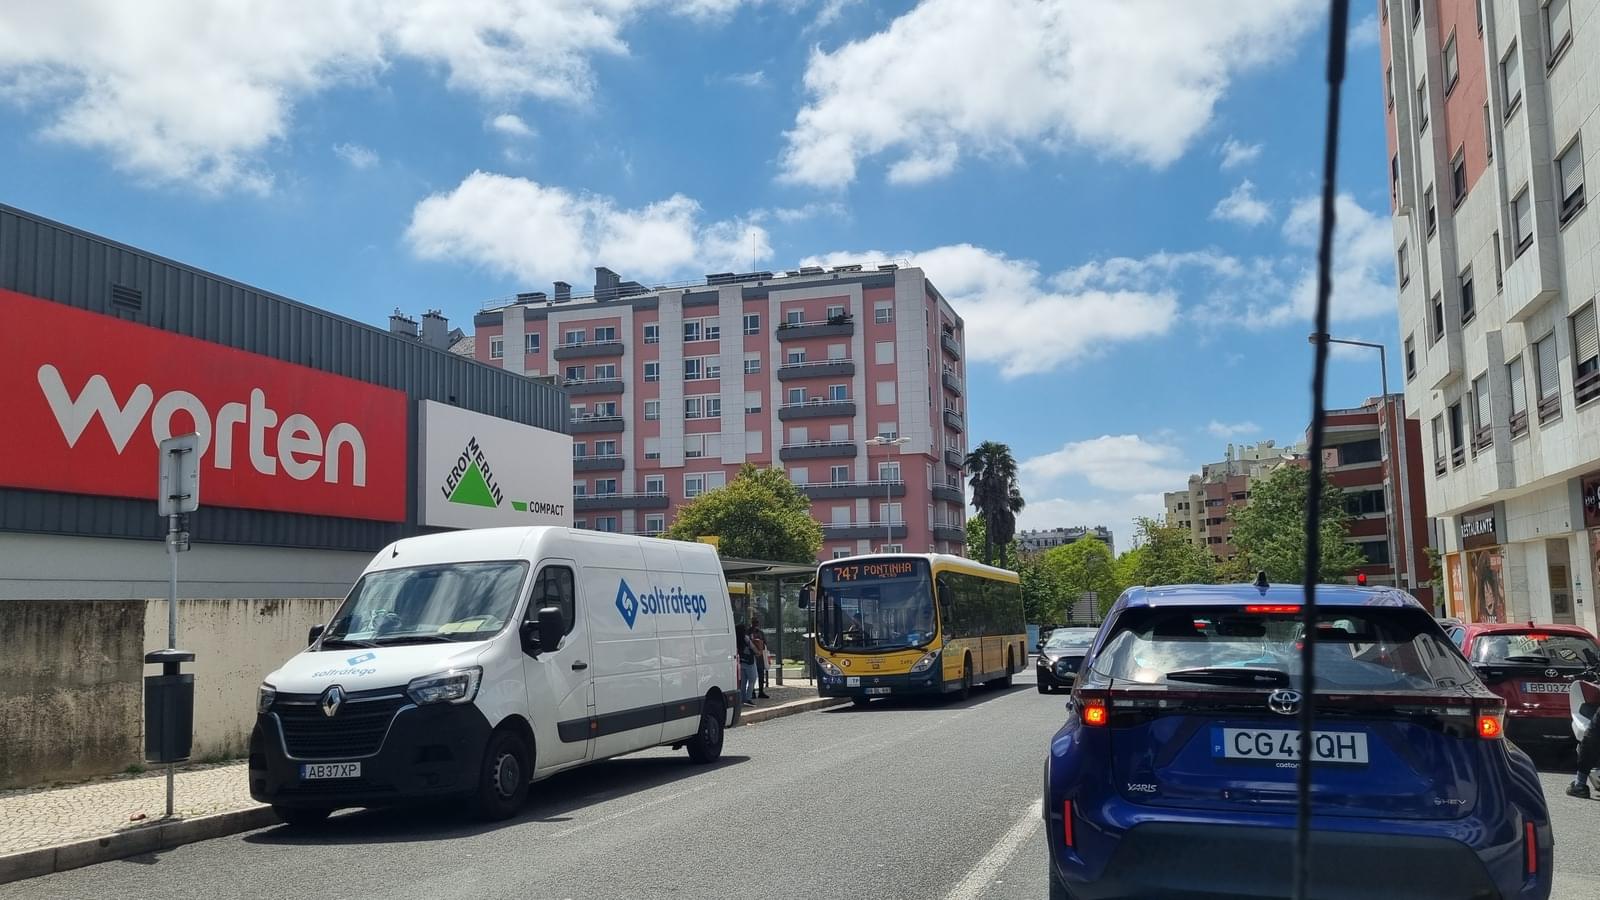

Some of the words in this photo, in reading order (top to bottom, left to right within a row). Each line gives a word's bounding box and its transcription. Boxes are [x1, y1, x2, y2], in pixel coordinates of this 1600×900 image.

[37, 364, 366, 487] worten
[441, 446, 472, 500] LEROY
[468, 436, 504, 506] MERLIN
[529, 501, 565, 516] COMPACT
[1461, 518, 1493, 538] RESTAURANTE
[833, 566, 859, 581] 747
[863, 562, 912, 576] PONTINHA
[640, 585, 707, 621] soltráfego
[308, 762, 358, 777] AB37XP
[1127, 783, 1158, 793] YARIS
